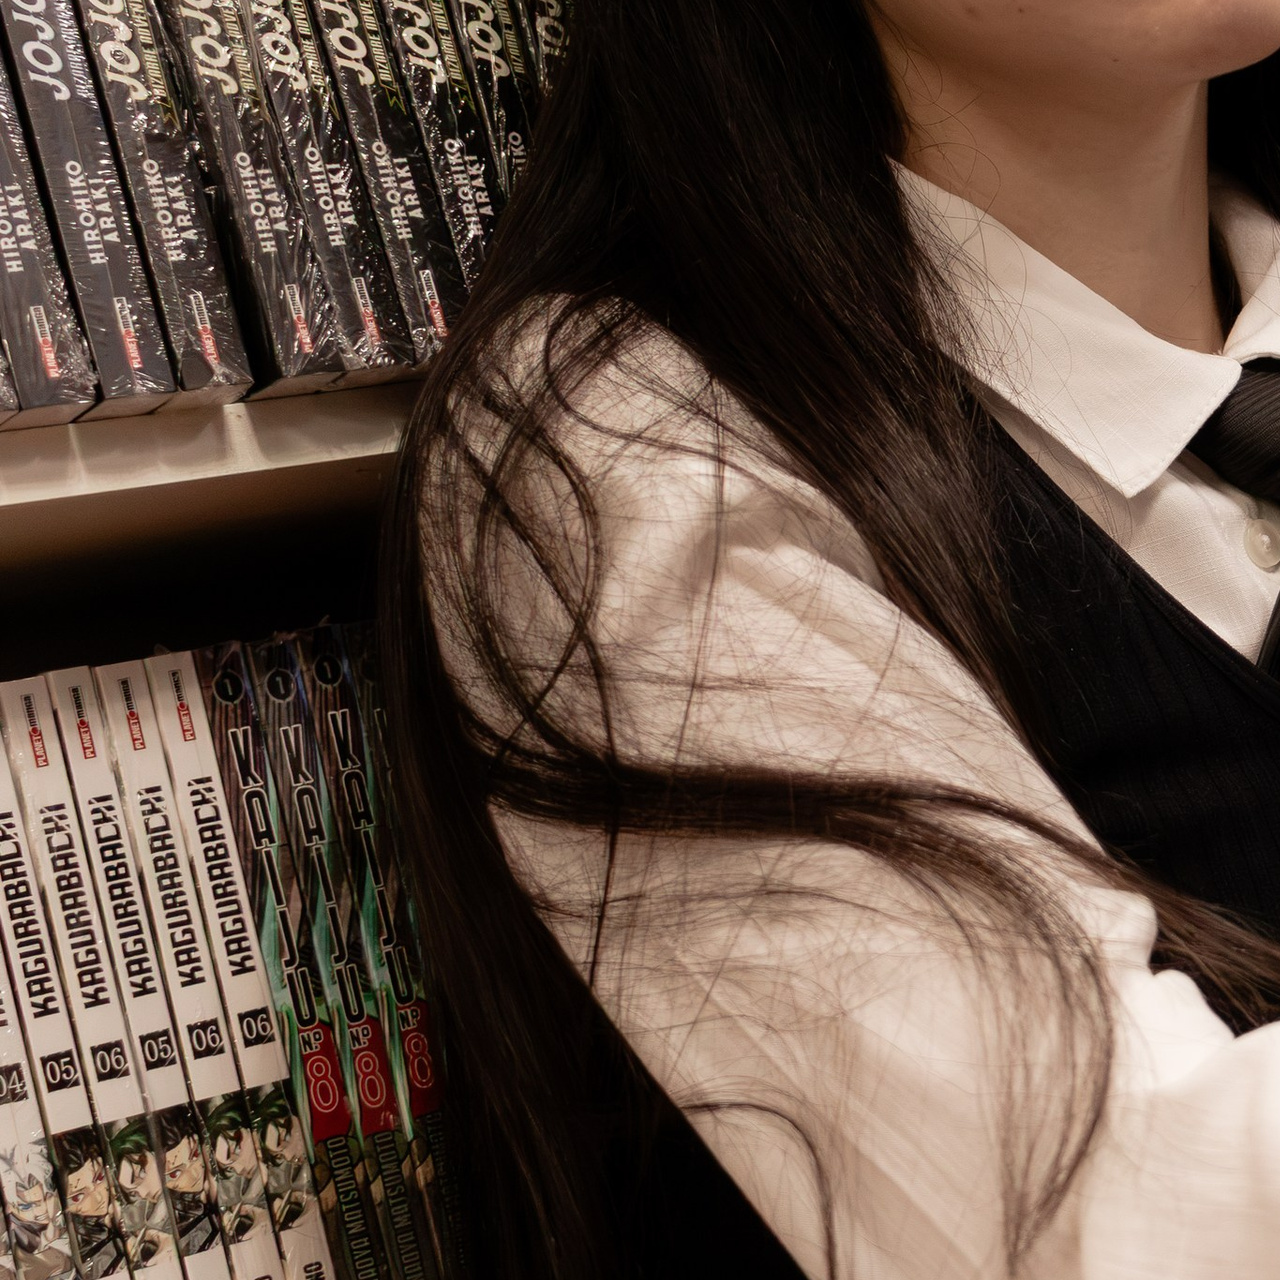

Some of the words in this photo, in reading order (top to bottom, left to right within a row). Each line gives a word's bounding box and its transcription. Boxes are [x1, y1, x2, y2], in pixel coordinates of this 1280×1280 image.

[143, 46, 167, 97] BIZARRE
[370, 33, 394, 82] BIZARRE
[440, 32, 465, 81] BIZARRE
[503, 29, 525, 74] BIZARRE
[66, 160, 108, 265] HIROHIKO
[88, 178, 121, 243] ARAKI
[142, 159, 184, 262] HIROHIKO
[165, 175, 198, 241] ARAKI
[236, 151, 277, 253] HIROHIKO
[257, 168, 289, 232] ARAKI
[305, 145, 346, 247] HIROHIKO
[326, 163, 358, 227] ARAKI
[372, 141, 413, 240] HIROHIKO
[393, 157, 424, 220] ARAKI
[444, 138, 484, 236] HIROHIKO
[464, 155, 494, 216] ARAKI
[5, 185, 37, 250] ARAKI
[38, 344, 60, 379] PLANET
[122, 335, 143, 368] PLANET
[23, 696, 40, 728] manga
[71, 687, 88, 718] manga
[120, 678, 136, 710] manga
[171, 670, 186, 702] manga
[31, 734, 48, 767] PLANET
[79, 727, 96, 759] PLANET
[128, 718, 146, 750] PLANET
[179, 710, 196, 742] PLANET
[187, 776, 257, 977] KAGURABACHI
[228, 725, 318, 1029] KAIJU
[280, 723, 367, 1025] KAIJU
[328, 708, 417, 1006] KAIJU
[39, 803, 111, 1010] KAGURABACHI
[88, 794, 158, 999] KAGURABACHI
[137, 785, 207, 988] KAGURABACHI
[144, 1036, 173, 1063] 05
[192, 1025, 220, 1051] 06
[242, 1013, 271, 1039] 06
[46, 1057, 76, 1085] 05
[97, 1047, 125, 1074] 06
[306, 1055, 339, 1113] 8
[355, 1050, 386, 1108] 8
[405, 1032, 435, 1089] 8
[326, 1136, 366, 1235] MATSUMOTO
